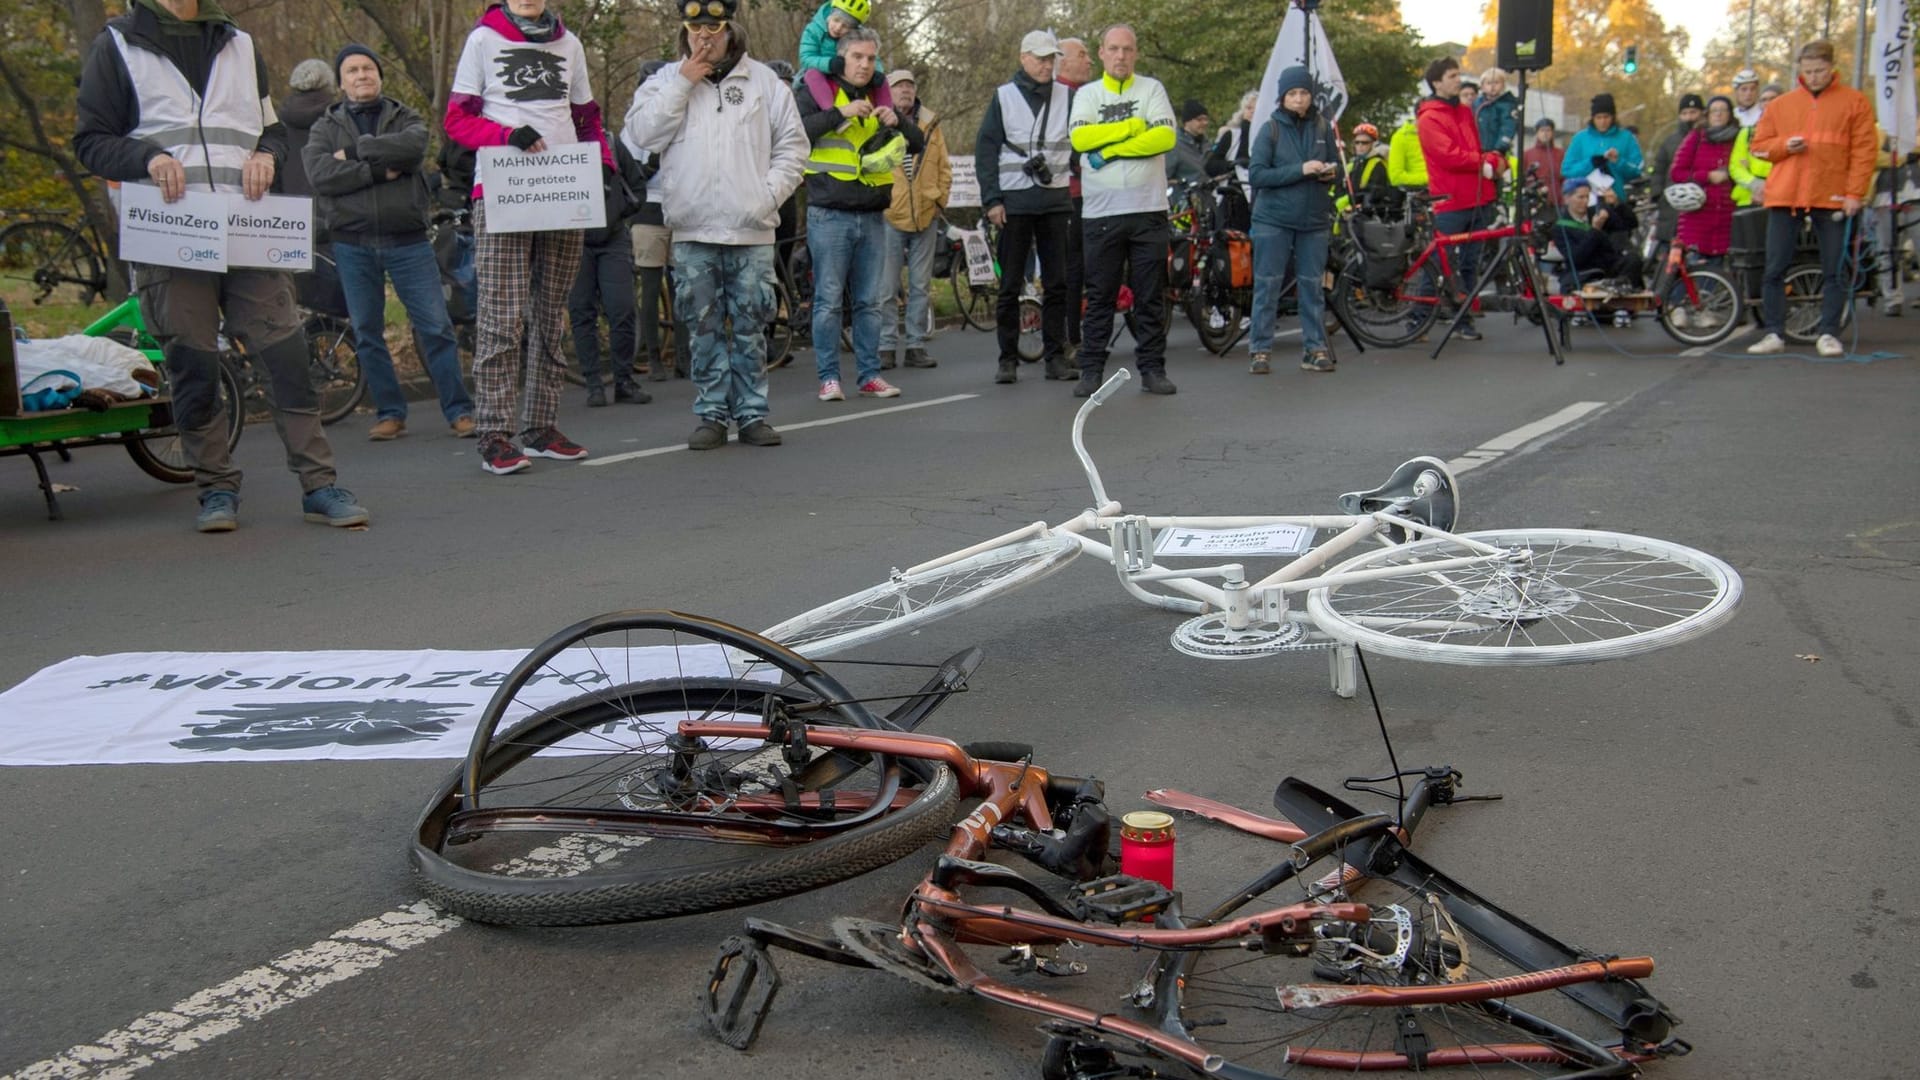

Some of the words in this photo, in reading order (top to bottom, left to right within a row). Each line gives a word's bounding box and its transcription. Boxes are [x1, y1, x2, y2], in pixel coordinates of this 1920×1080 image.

[492, 153, 589, 169] MAHNWACHE
[508, 175, 525, 186] für
[527, 174, 577, 187] getötete
[497, 190, 590, 205] RADFAHRERIN
[128, 206, 219, 231] #VisionZero
[227, 214, 306, 231] VisionZero
[194, 247, 220, 261] adfc
[283, 248, 308, 260] adfc
